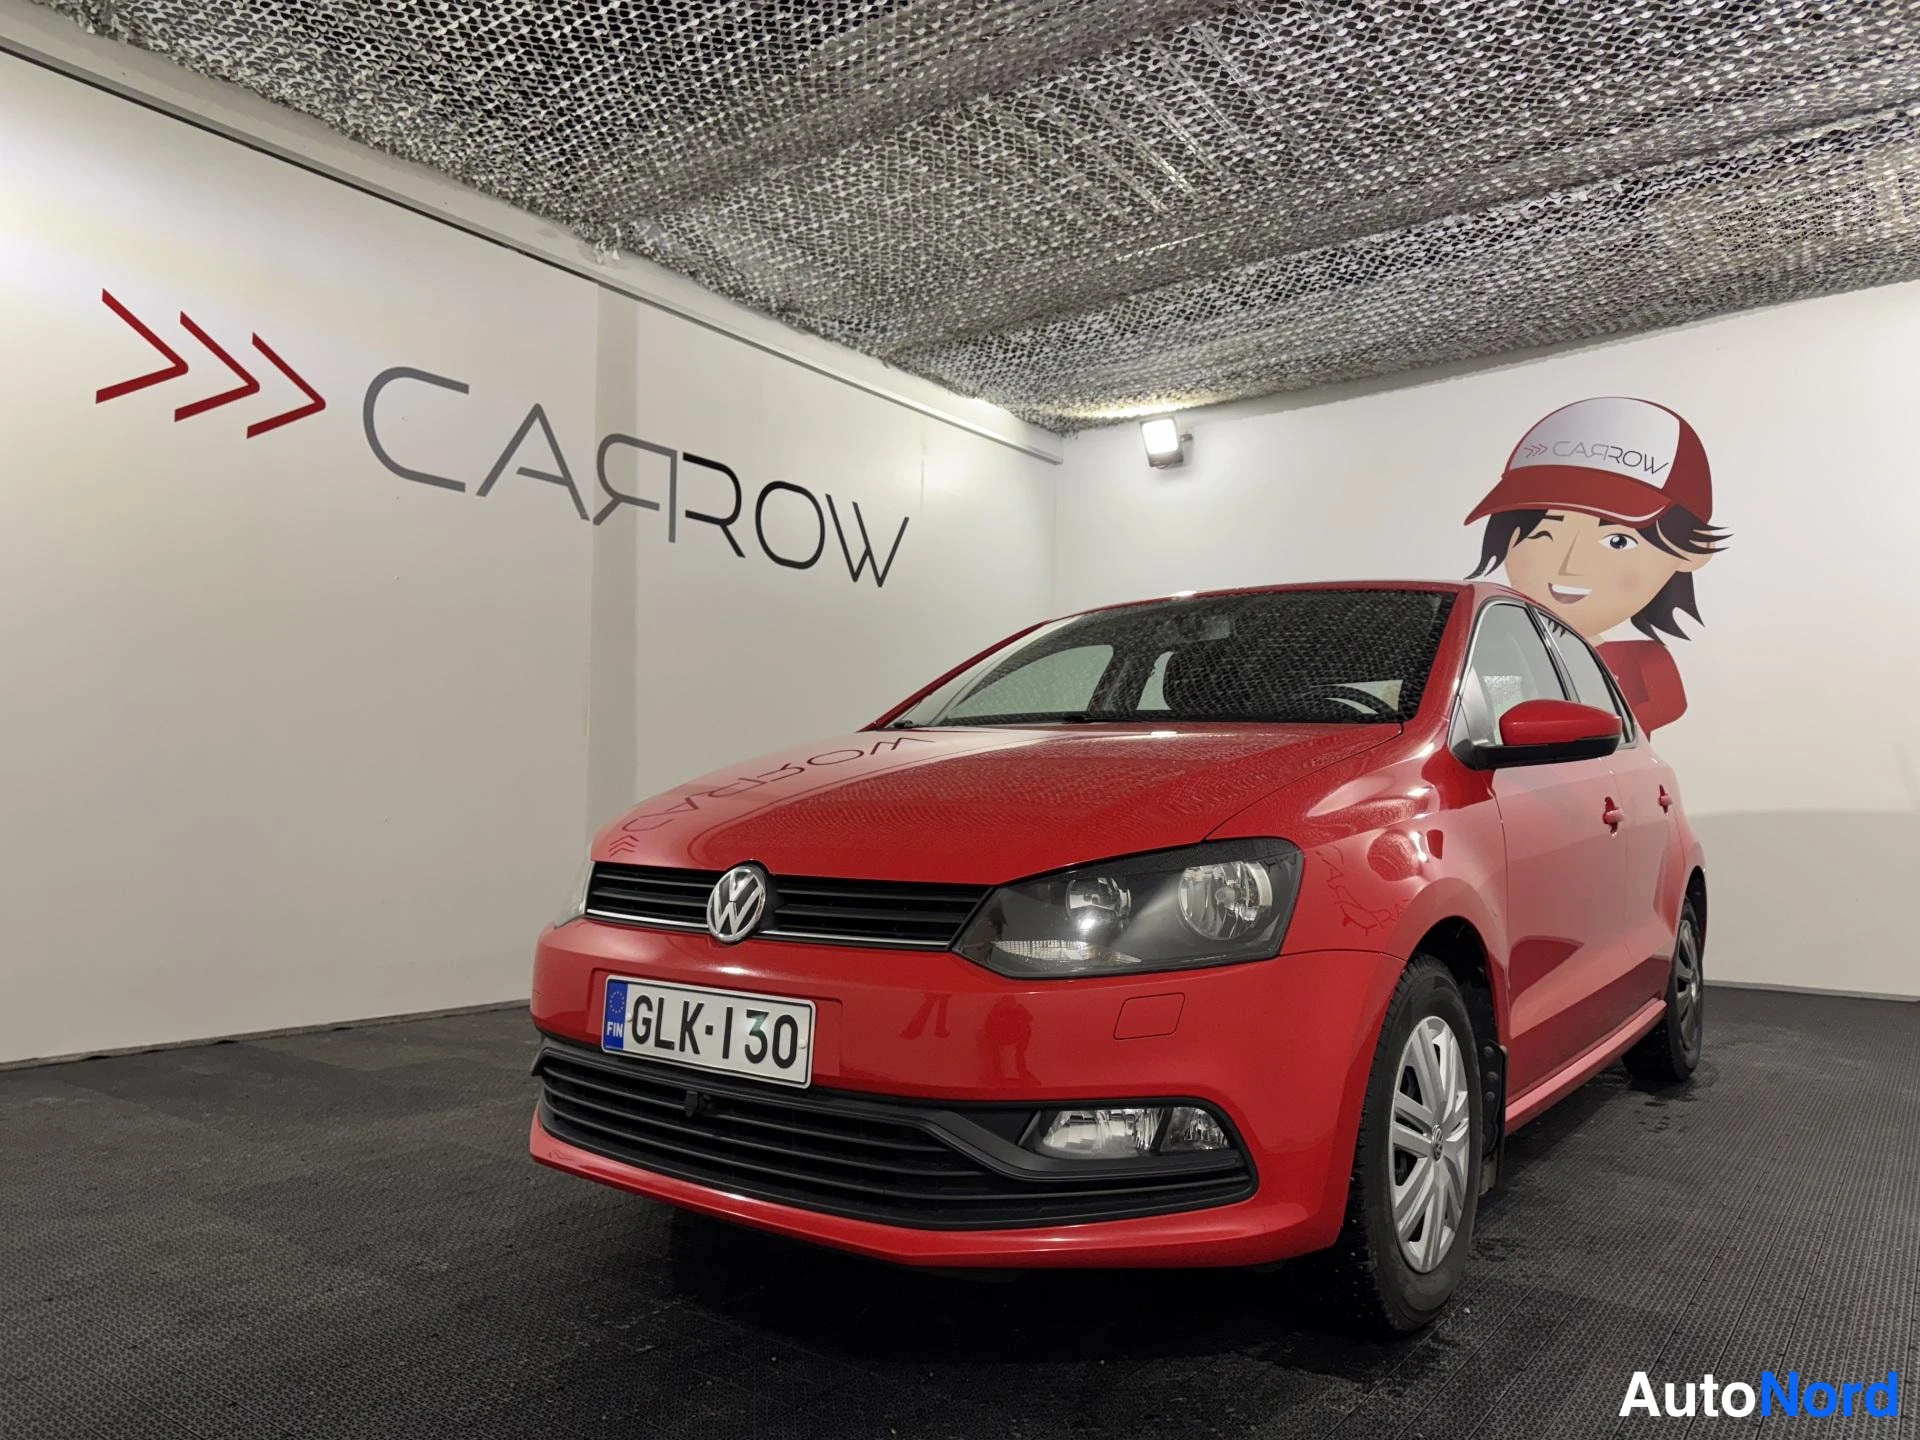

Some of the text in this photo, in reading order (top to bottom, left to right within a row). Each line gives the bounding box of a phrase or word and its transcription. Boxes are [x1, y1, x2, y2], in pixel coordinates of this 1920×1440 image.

[363, 366, 909, 587] CARROW
[1553, 441, 1669, 474] CARROW
[709, 866, 765, 940] VW
[606, 1021, 624, 1038] FIN
